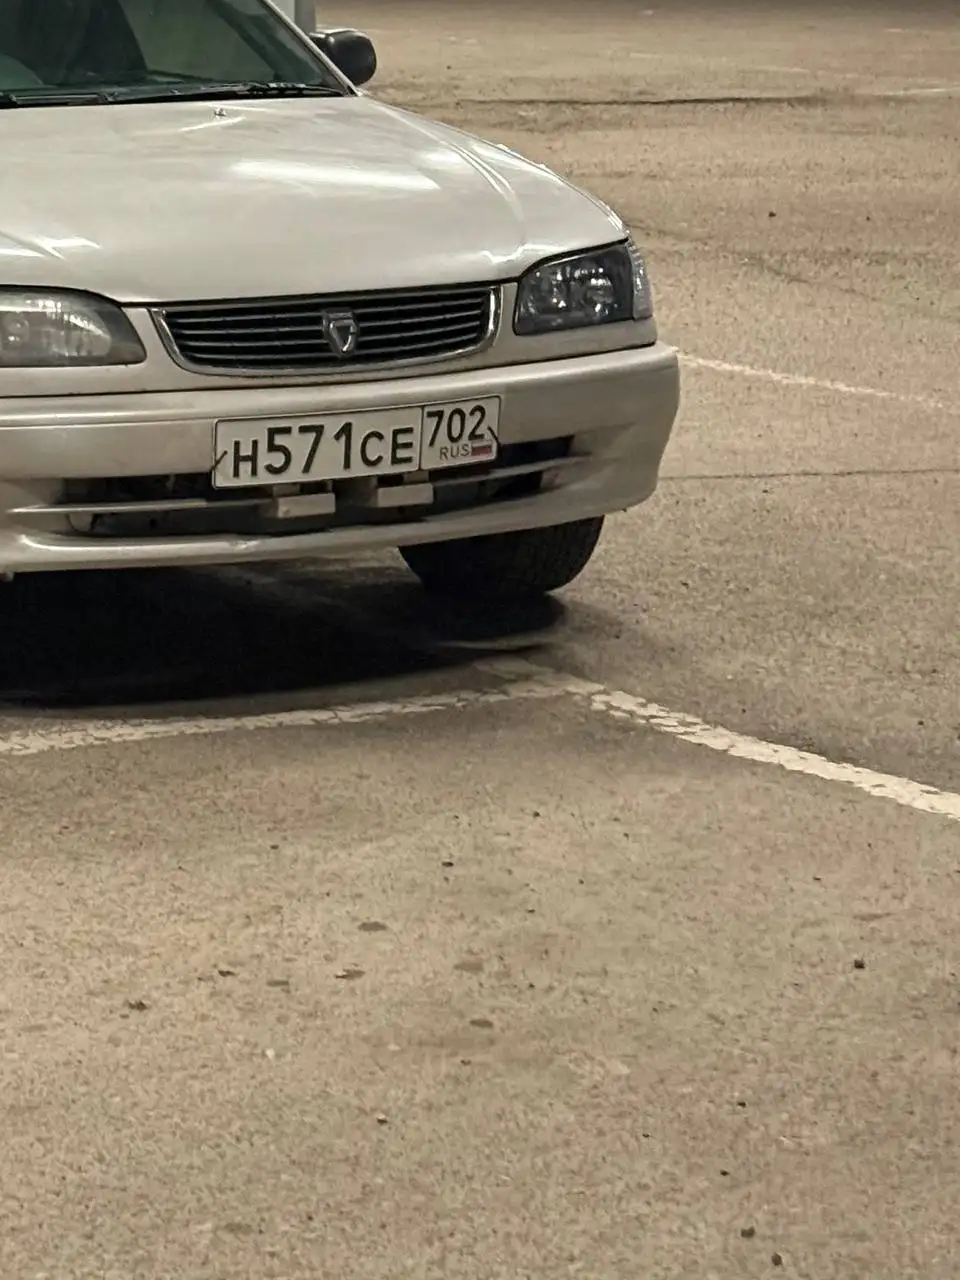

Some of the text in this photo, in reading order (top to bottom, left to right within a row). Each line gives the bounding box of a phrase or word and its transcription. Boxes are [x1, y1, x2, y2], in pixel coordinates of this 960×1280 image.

[233, 405, 486, 478] Н571СЕ 702
[439, 441, 470, 460] RUS
